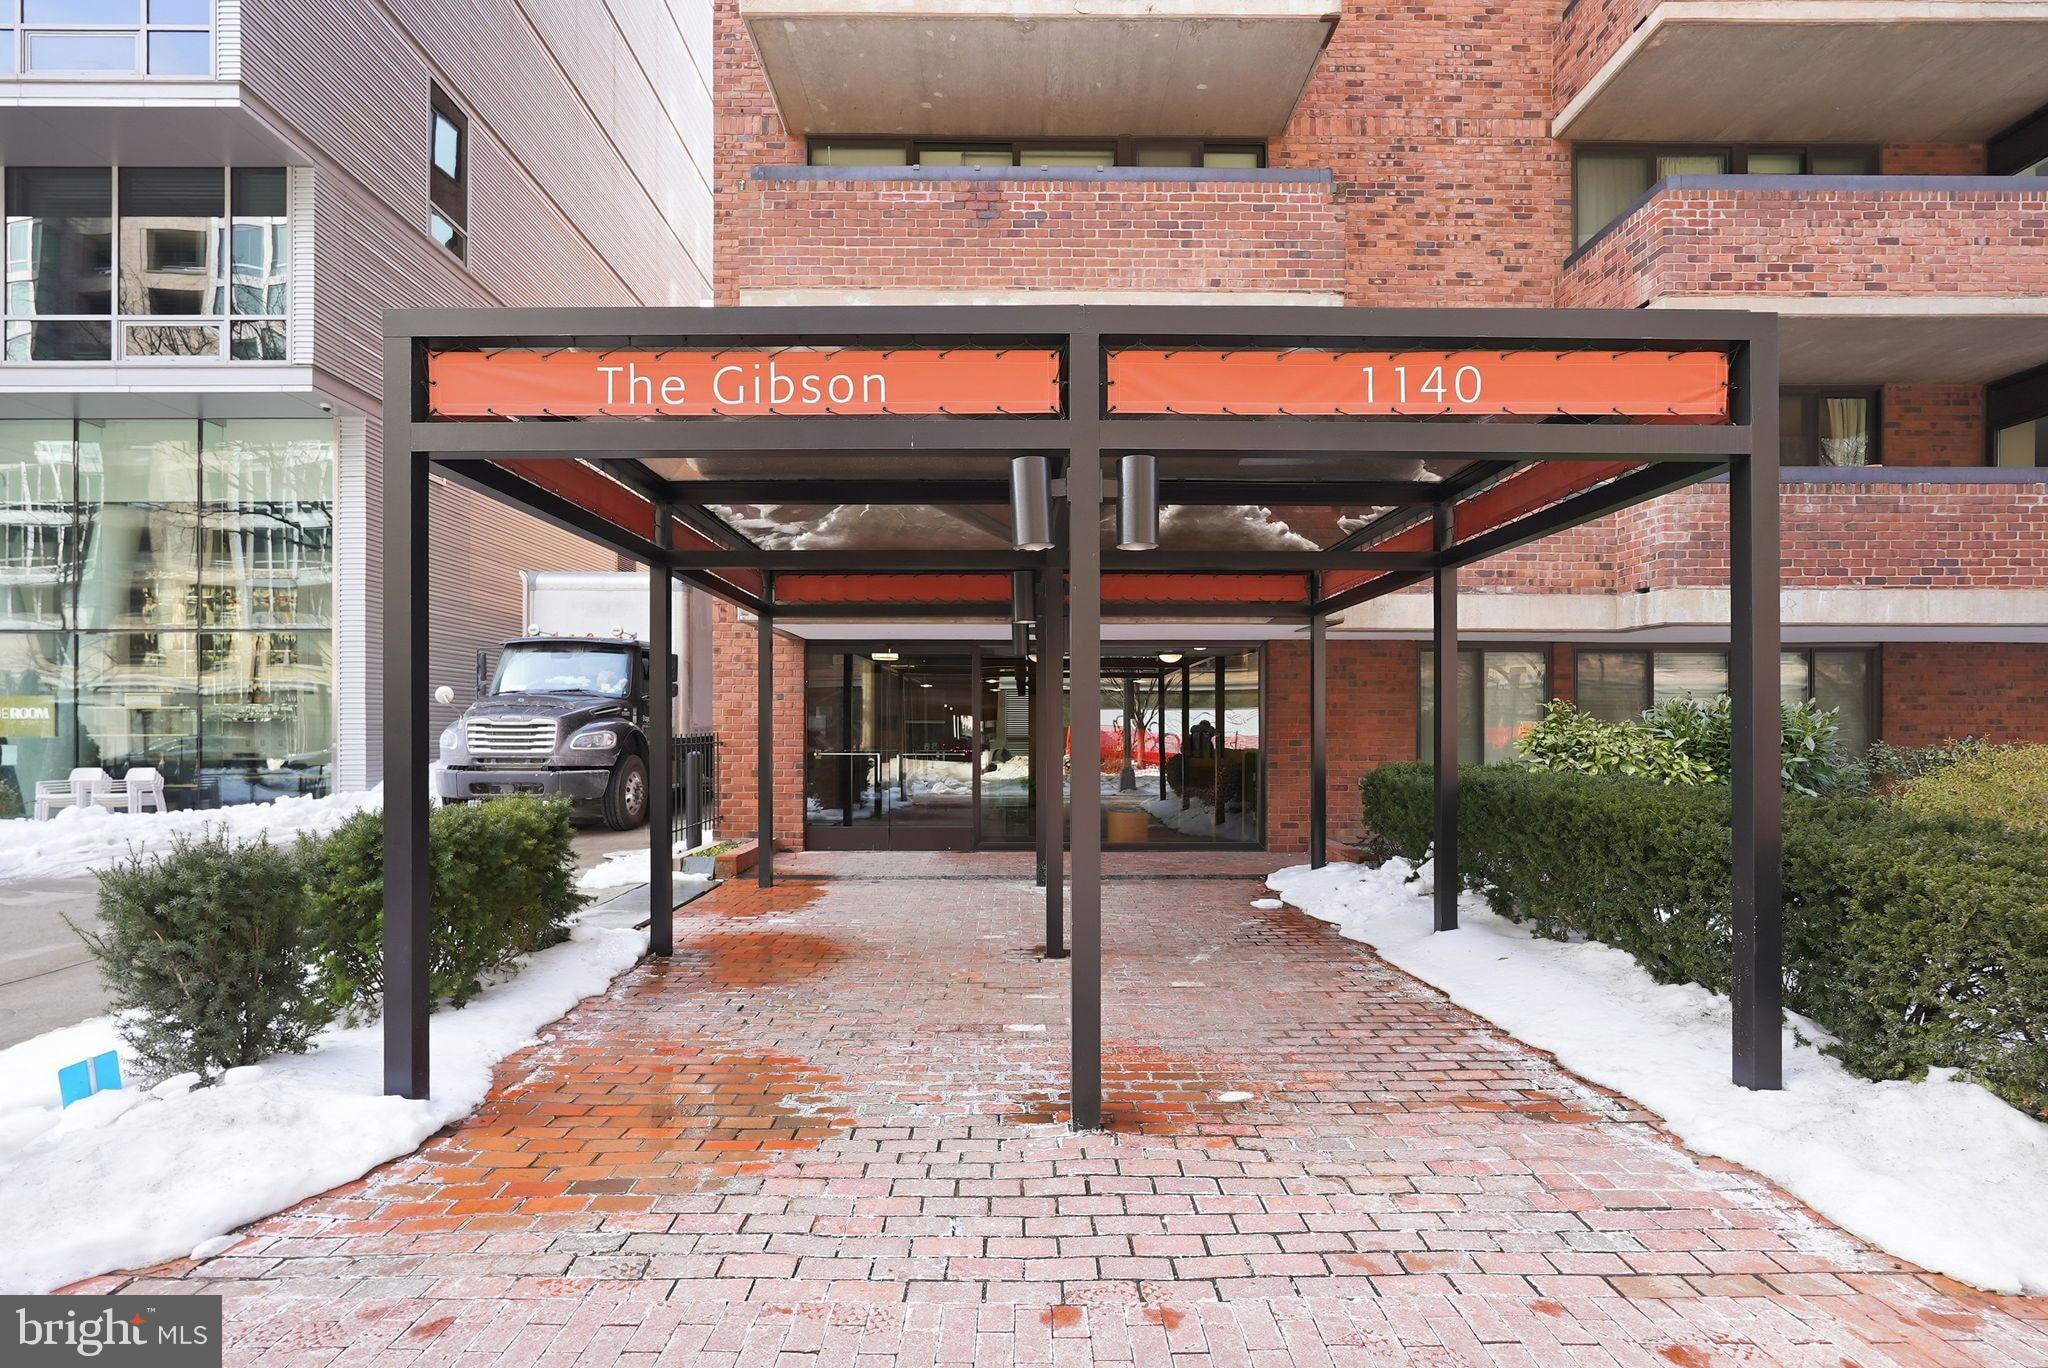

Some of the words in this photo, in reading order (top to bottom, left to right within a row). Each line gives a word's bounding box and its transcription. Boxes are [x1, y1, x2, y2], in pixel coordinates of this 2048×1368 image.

[597, 363, 686, 405] The
[712, 362, 887, 405] Gibson
[1363, 365, 1482, 404] 1140
